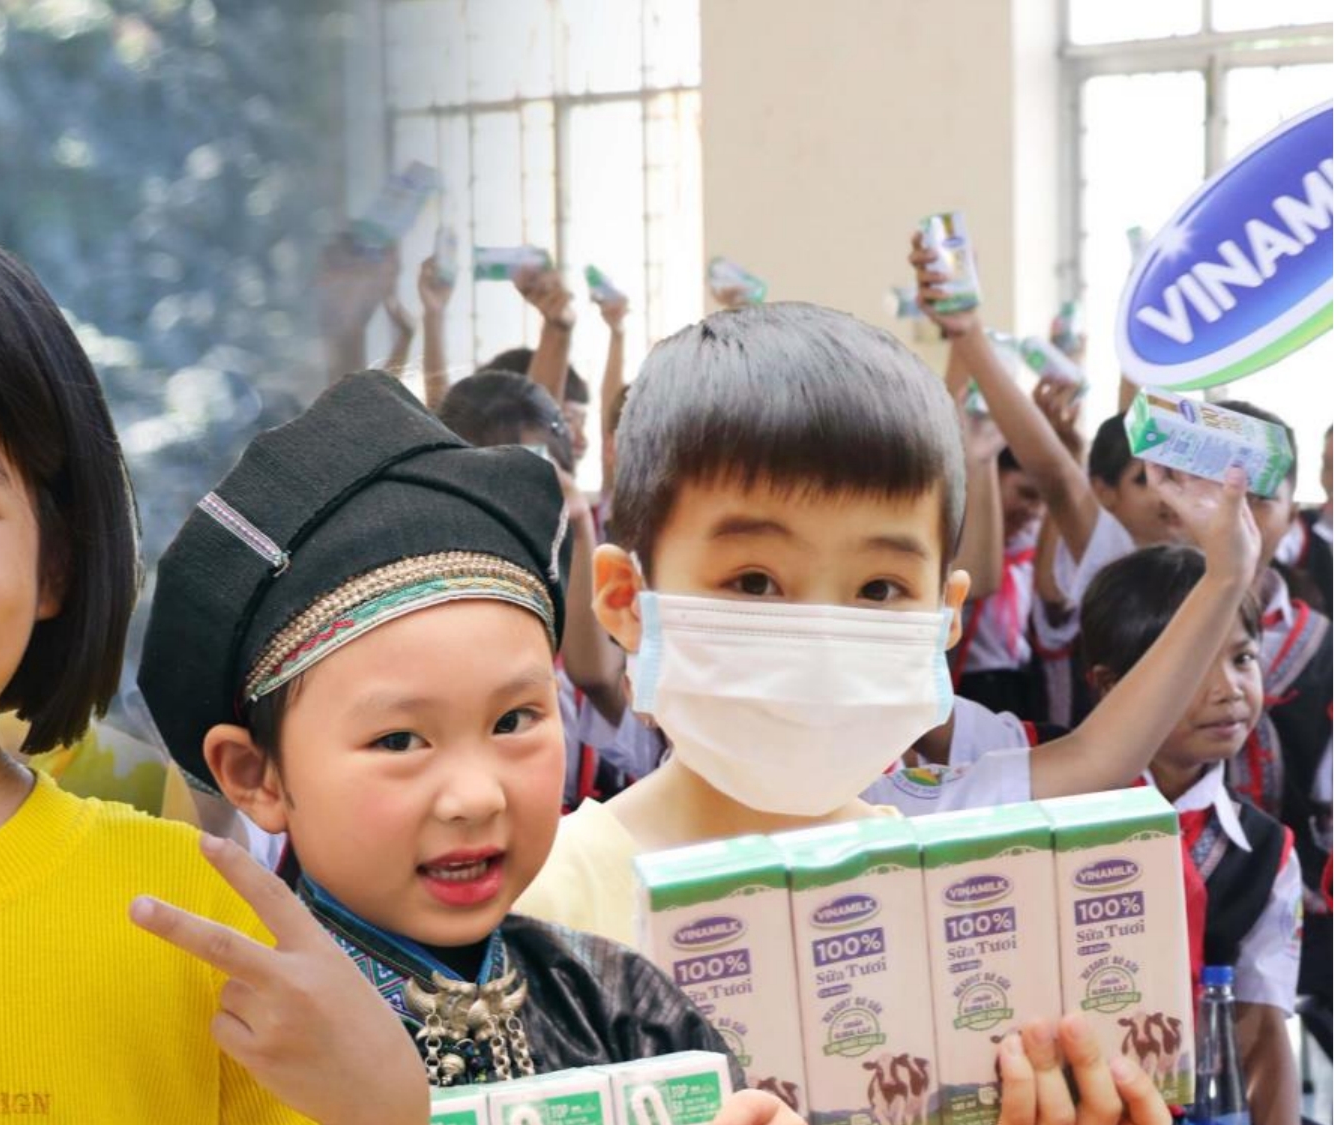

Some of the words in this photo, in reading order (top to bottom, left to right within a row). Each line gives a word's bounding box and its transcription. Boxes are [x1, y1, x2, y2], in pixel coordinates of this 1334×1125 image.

[1078, 863, 1135, 883] VINAMILK
[948, 880, 1006, 899] VINAMILK
[816, 899, 877, 922] VINAMILK
[1077, 896, 1141, 923] 100%
[676, 921, 743, 942] VINAMILK
[948, 912, 1013, 939] 100%
[1075, 928, 1104, 944] Sữa
[1104, 919, 1145, 938] Tươi
[816, 932, 882, 962] 100%
[946, 946, 976, 961] Sữa
[975, 934, 1017, 954] Tươi
[677, 954, 748, 983] 100%
[816, 968, 845, 985] Sữa
[845, 956, 887, 977] Tươi
[710, 978, 753, 999] Tươi
